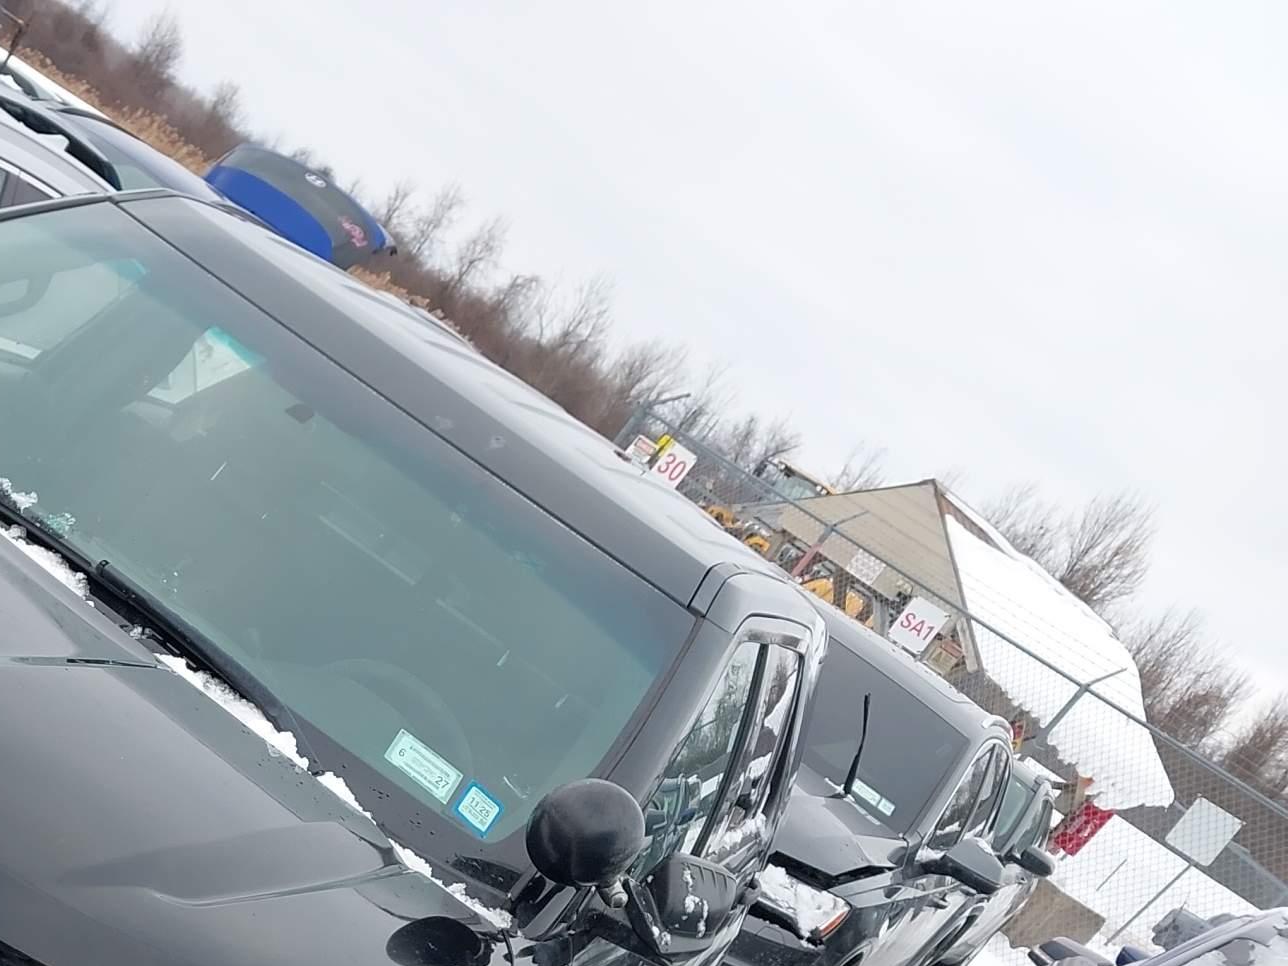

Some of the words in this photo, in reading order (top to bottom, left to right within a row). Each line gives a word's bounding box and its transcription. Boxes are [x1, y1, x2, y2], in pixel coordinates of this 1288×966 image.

[657, 453, 687, 481] 30
[900, 612, 935, 641] SA1
[435, 775, 450, 789] 27
